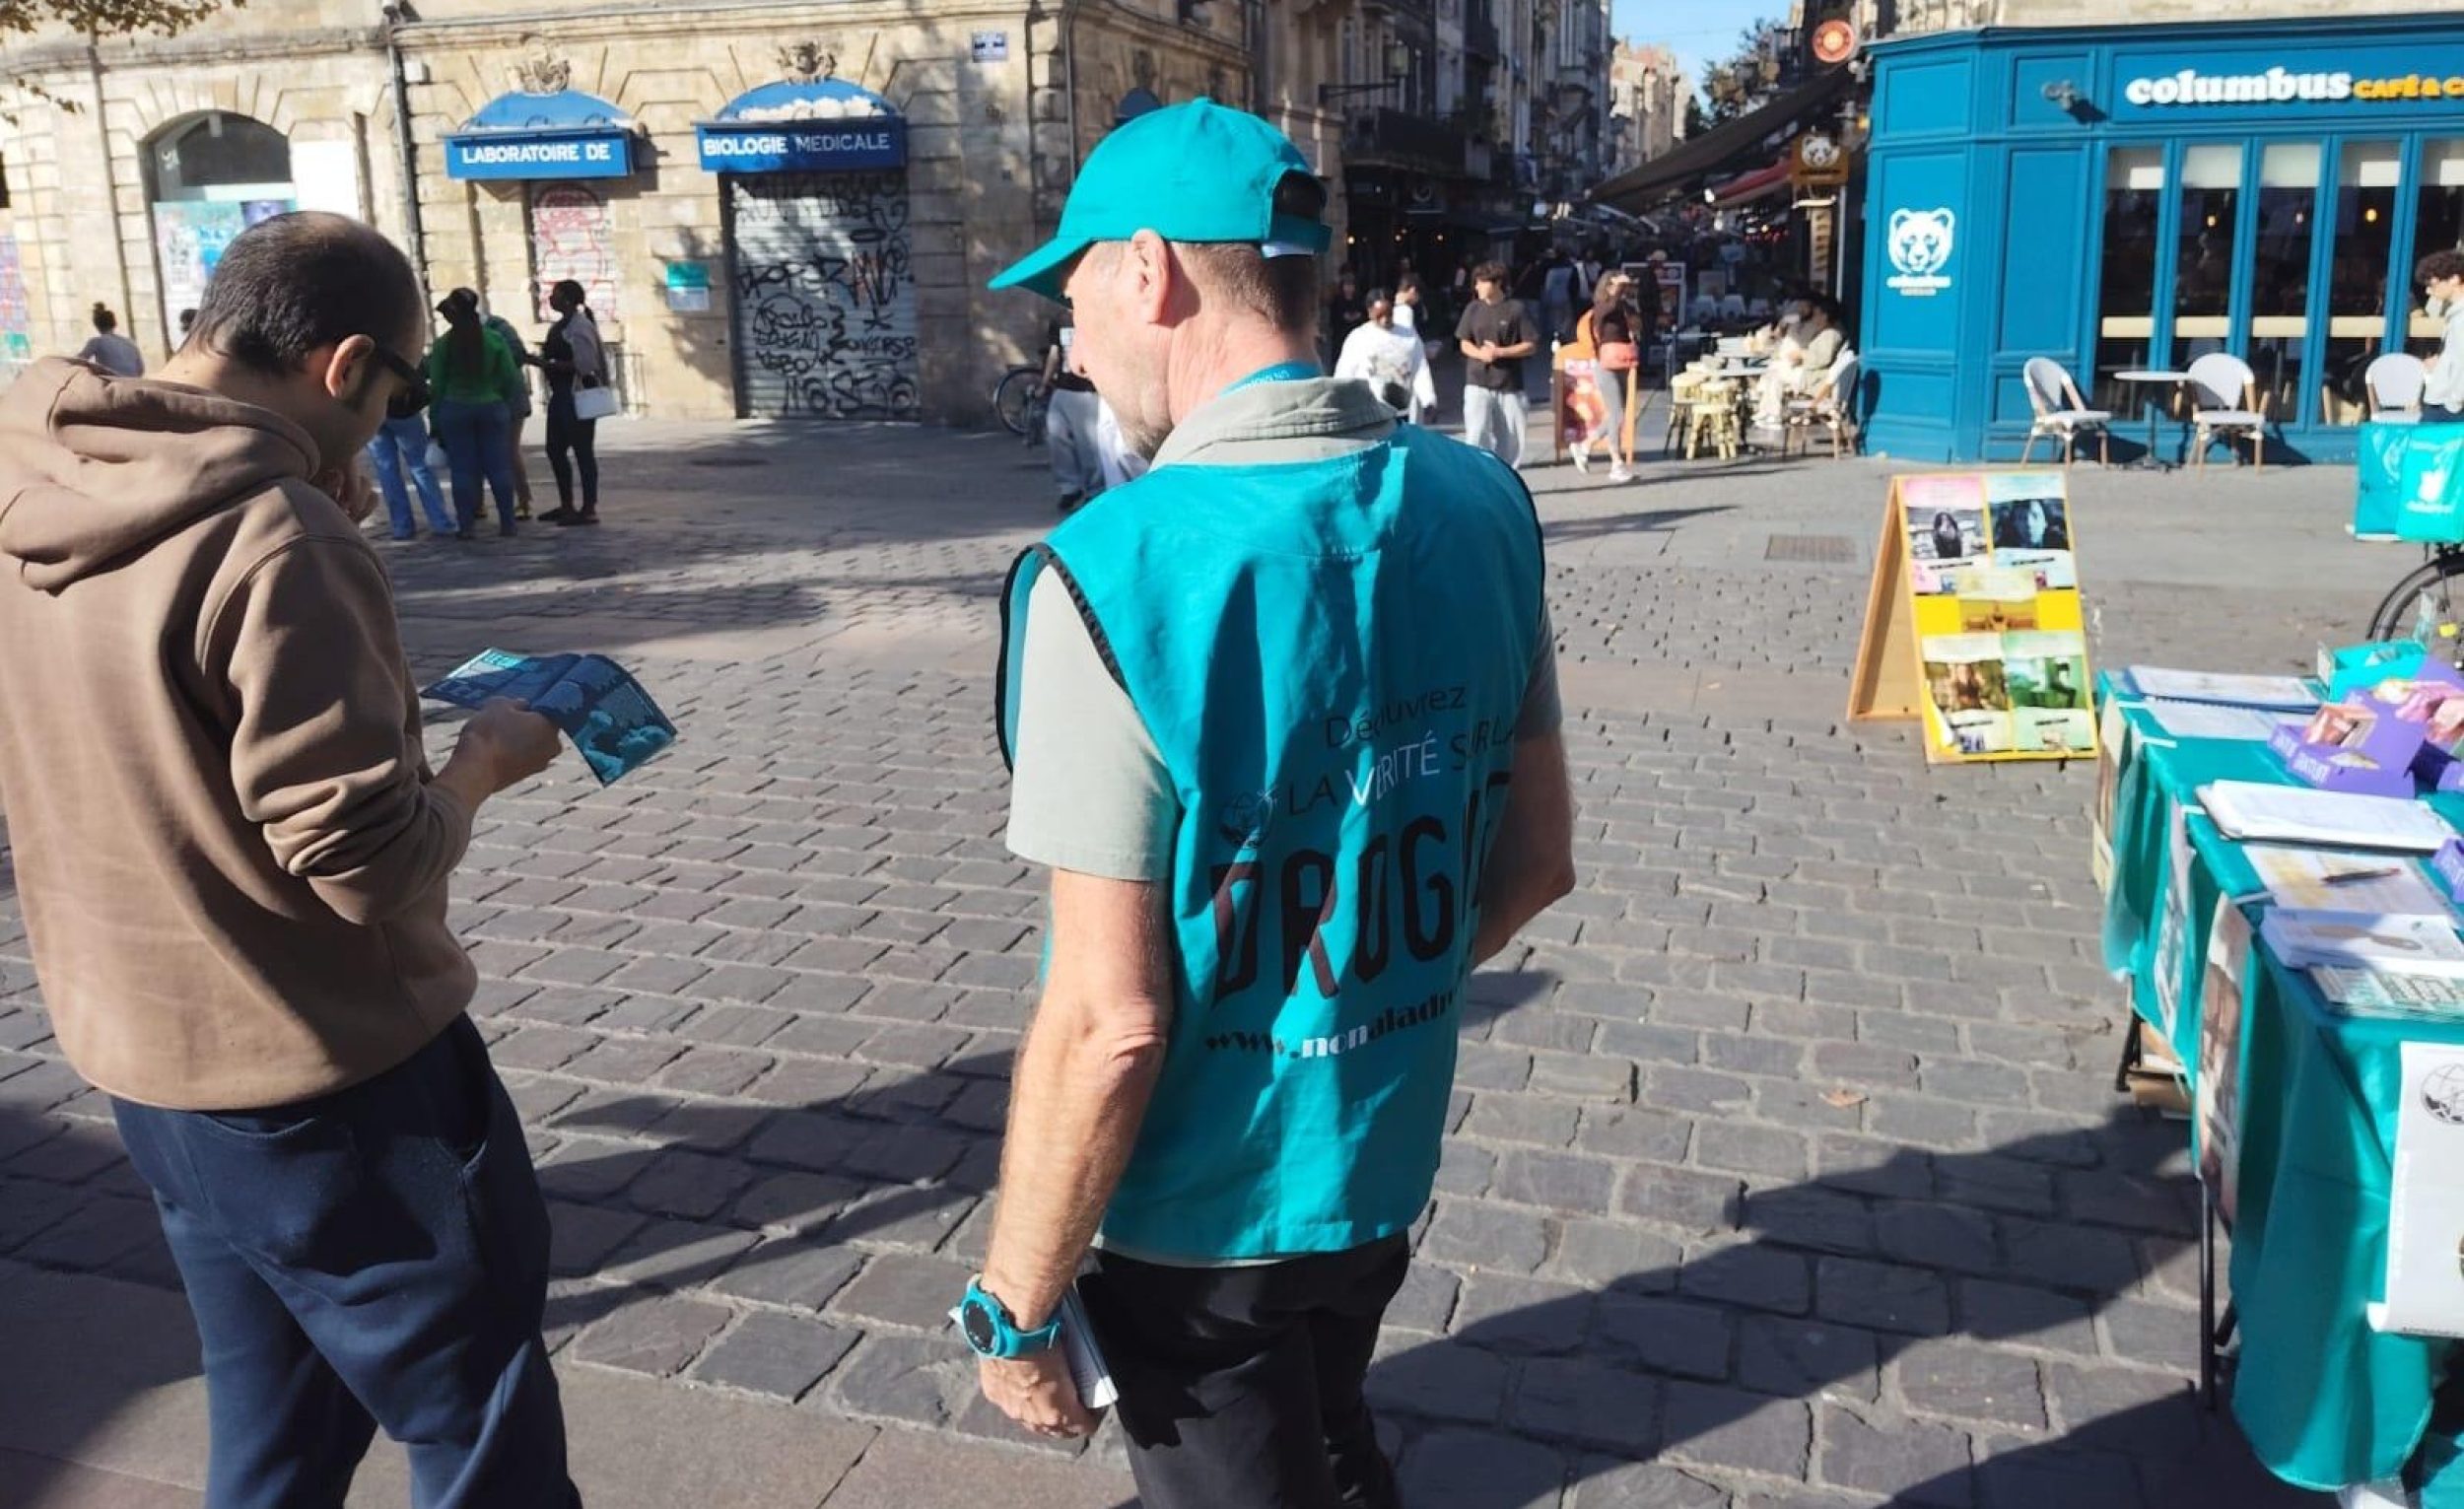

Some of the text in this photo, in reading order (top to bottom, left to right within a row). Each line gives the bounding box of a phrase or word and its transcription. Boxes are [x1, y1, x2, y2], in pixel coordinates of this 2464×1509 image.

[2125, 66, 2353, 104] columbus
[2353, 73, 2419, 100] CAFÉ
[462, 141, 612, 165] LABORATOIRE DE
[702, 132, 891, 157] BIOLOGIE MEDICALE
[1326, 685, 1467, 749] Décuvrez
[1288, 772, 1338, 816] LA
[1209, 770, 1511, 1008] DROG
